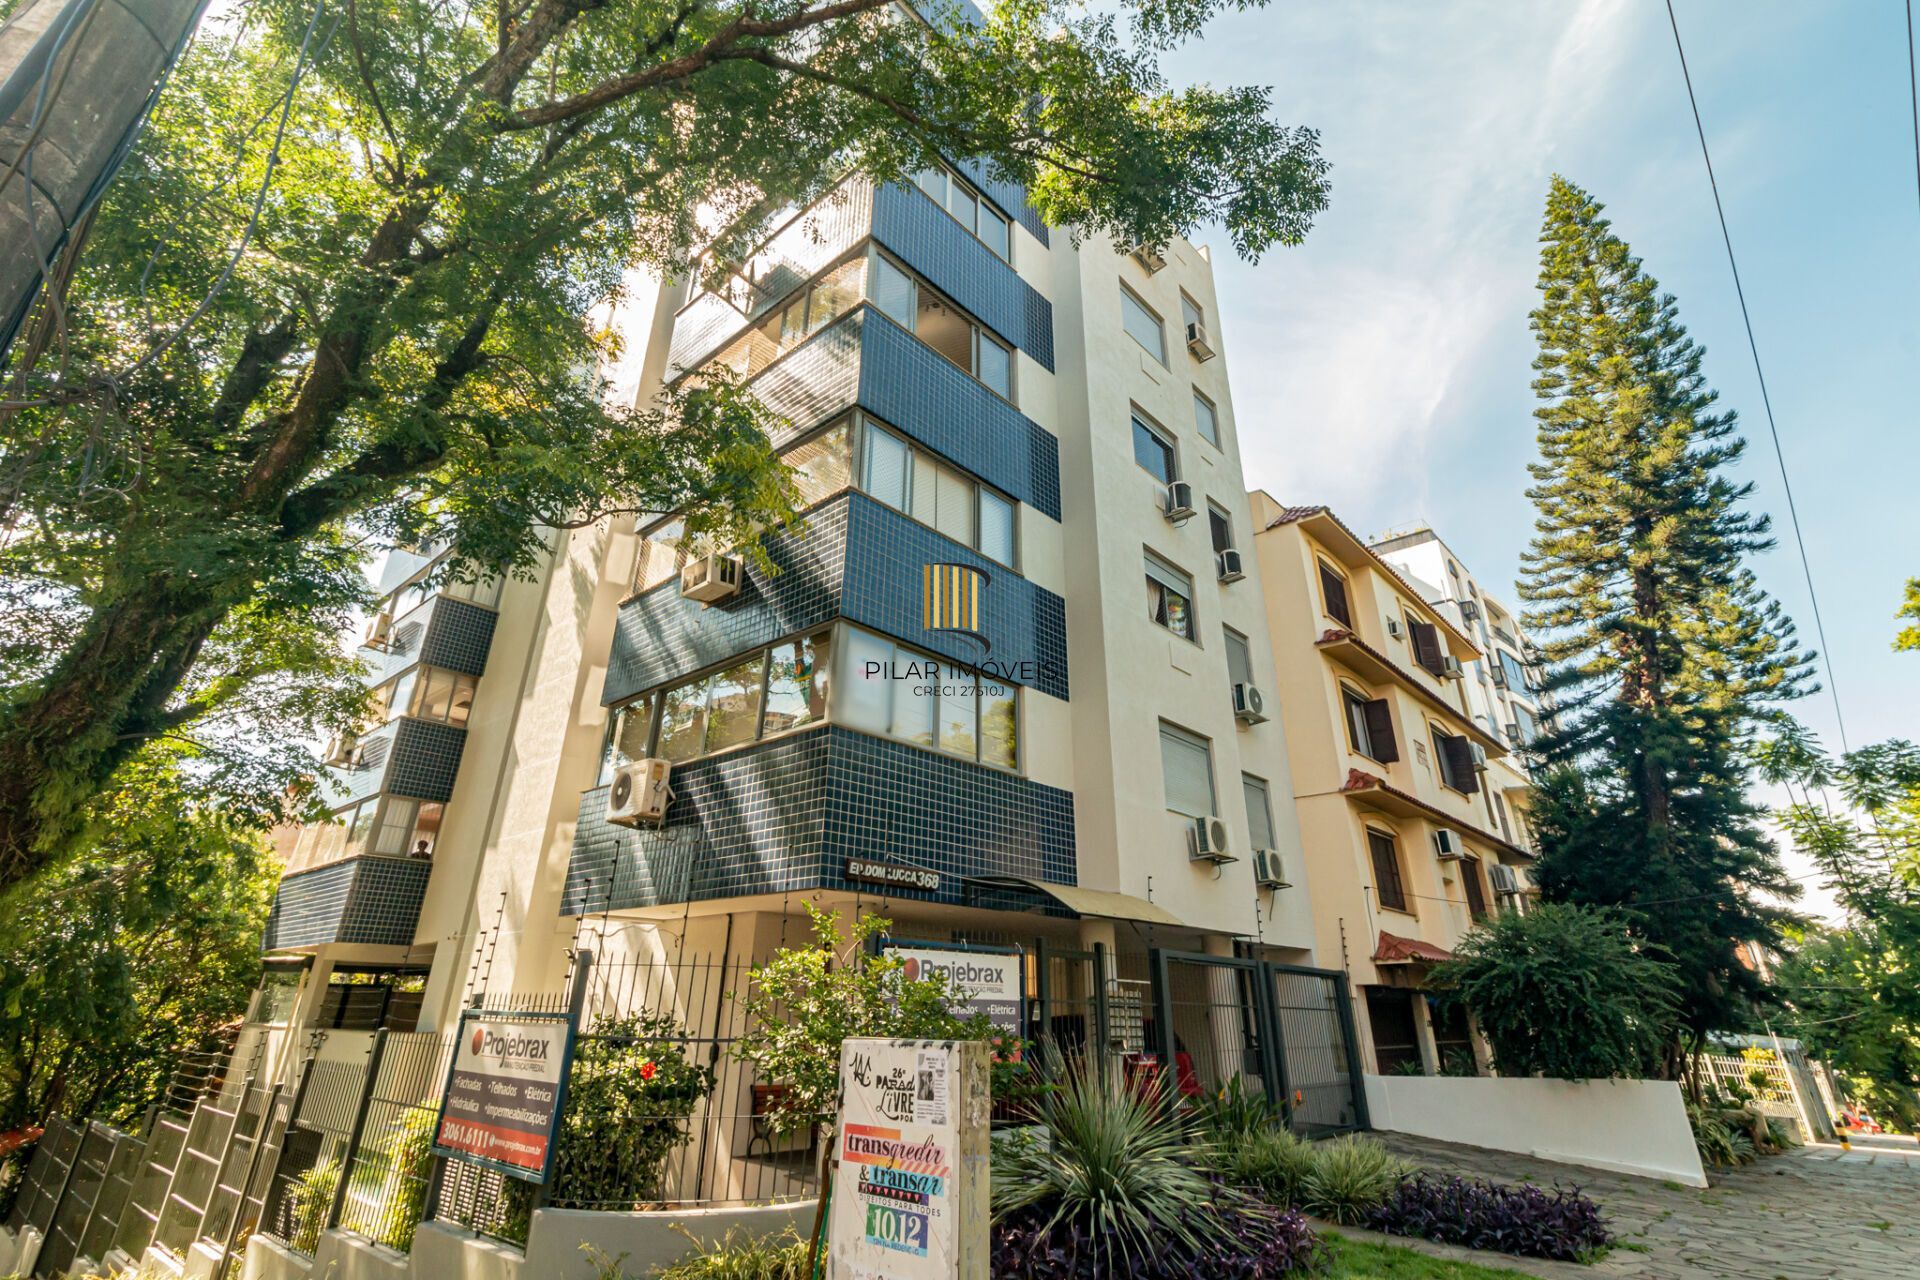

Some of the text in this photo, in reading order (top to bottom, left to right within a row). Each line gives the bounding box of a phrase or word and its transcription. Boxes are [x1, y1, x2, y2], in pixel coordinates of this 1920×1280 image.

[916, 871, 940, 889] 368
[481, 1030, 550, 1068] Projebrax
[456, 1076, 552, 1103] Fachadas Telhados Elétrica
[452, 1096, 548, 1126] Hidráulica Impermeabilizações
[900, 1114, 914, 1123] POA
[443, 1122, 490, 1149] 3061.6111
[848, 1133, 945, 1170] transgredir
[859, 1164, 944, 1196] & transar
[858, 1193, 941, 1217] DIREITOS PARA TODES
[874, 1207, 921, 1248] 10.12
